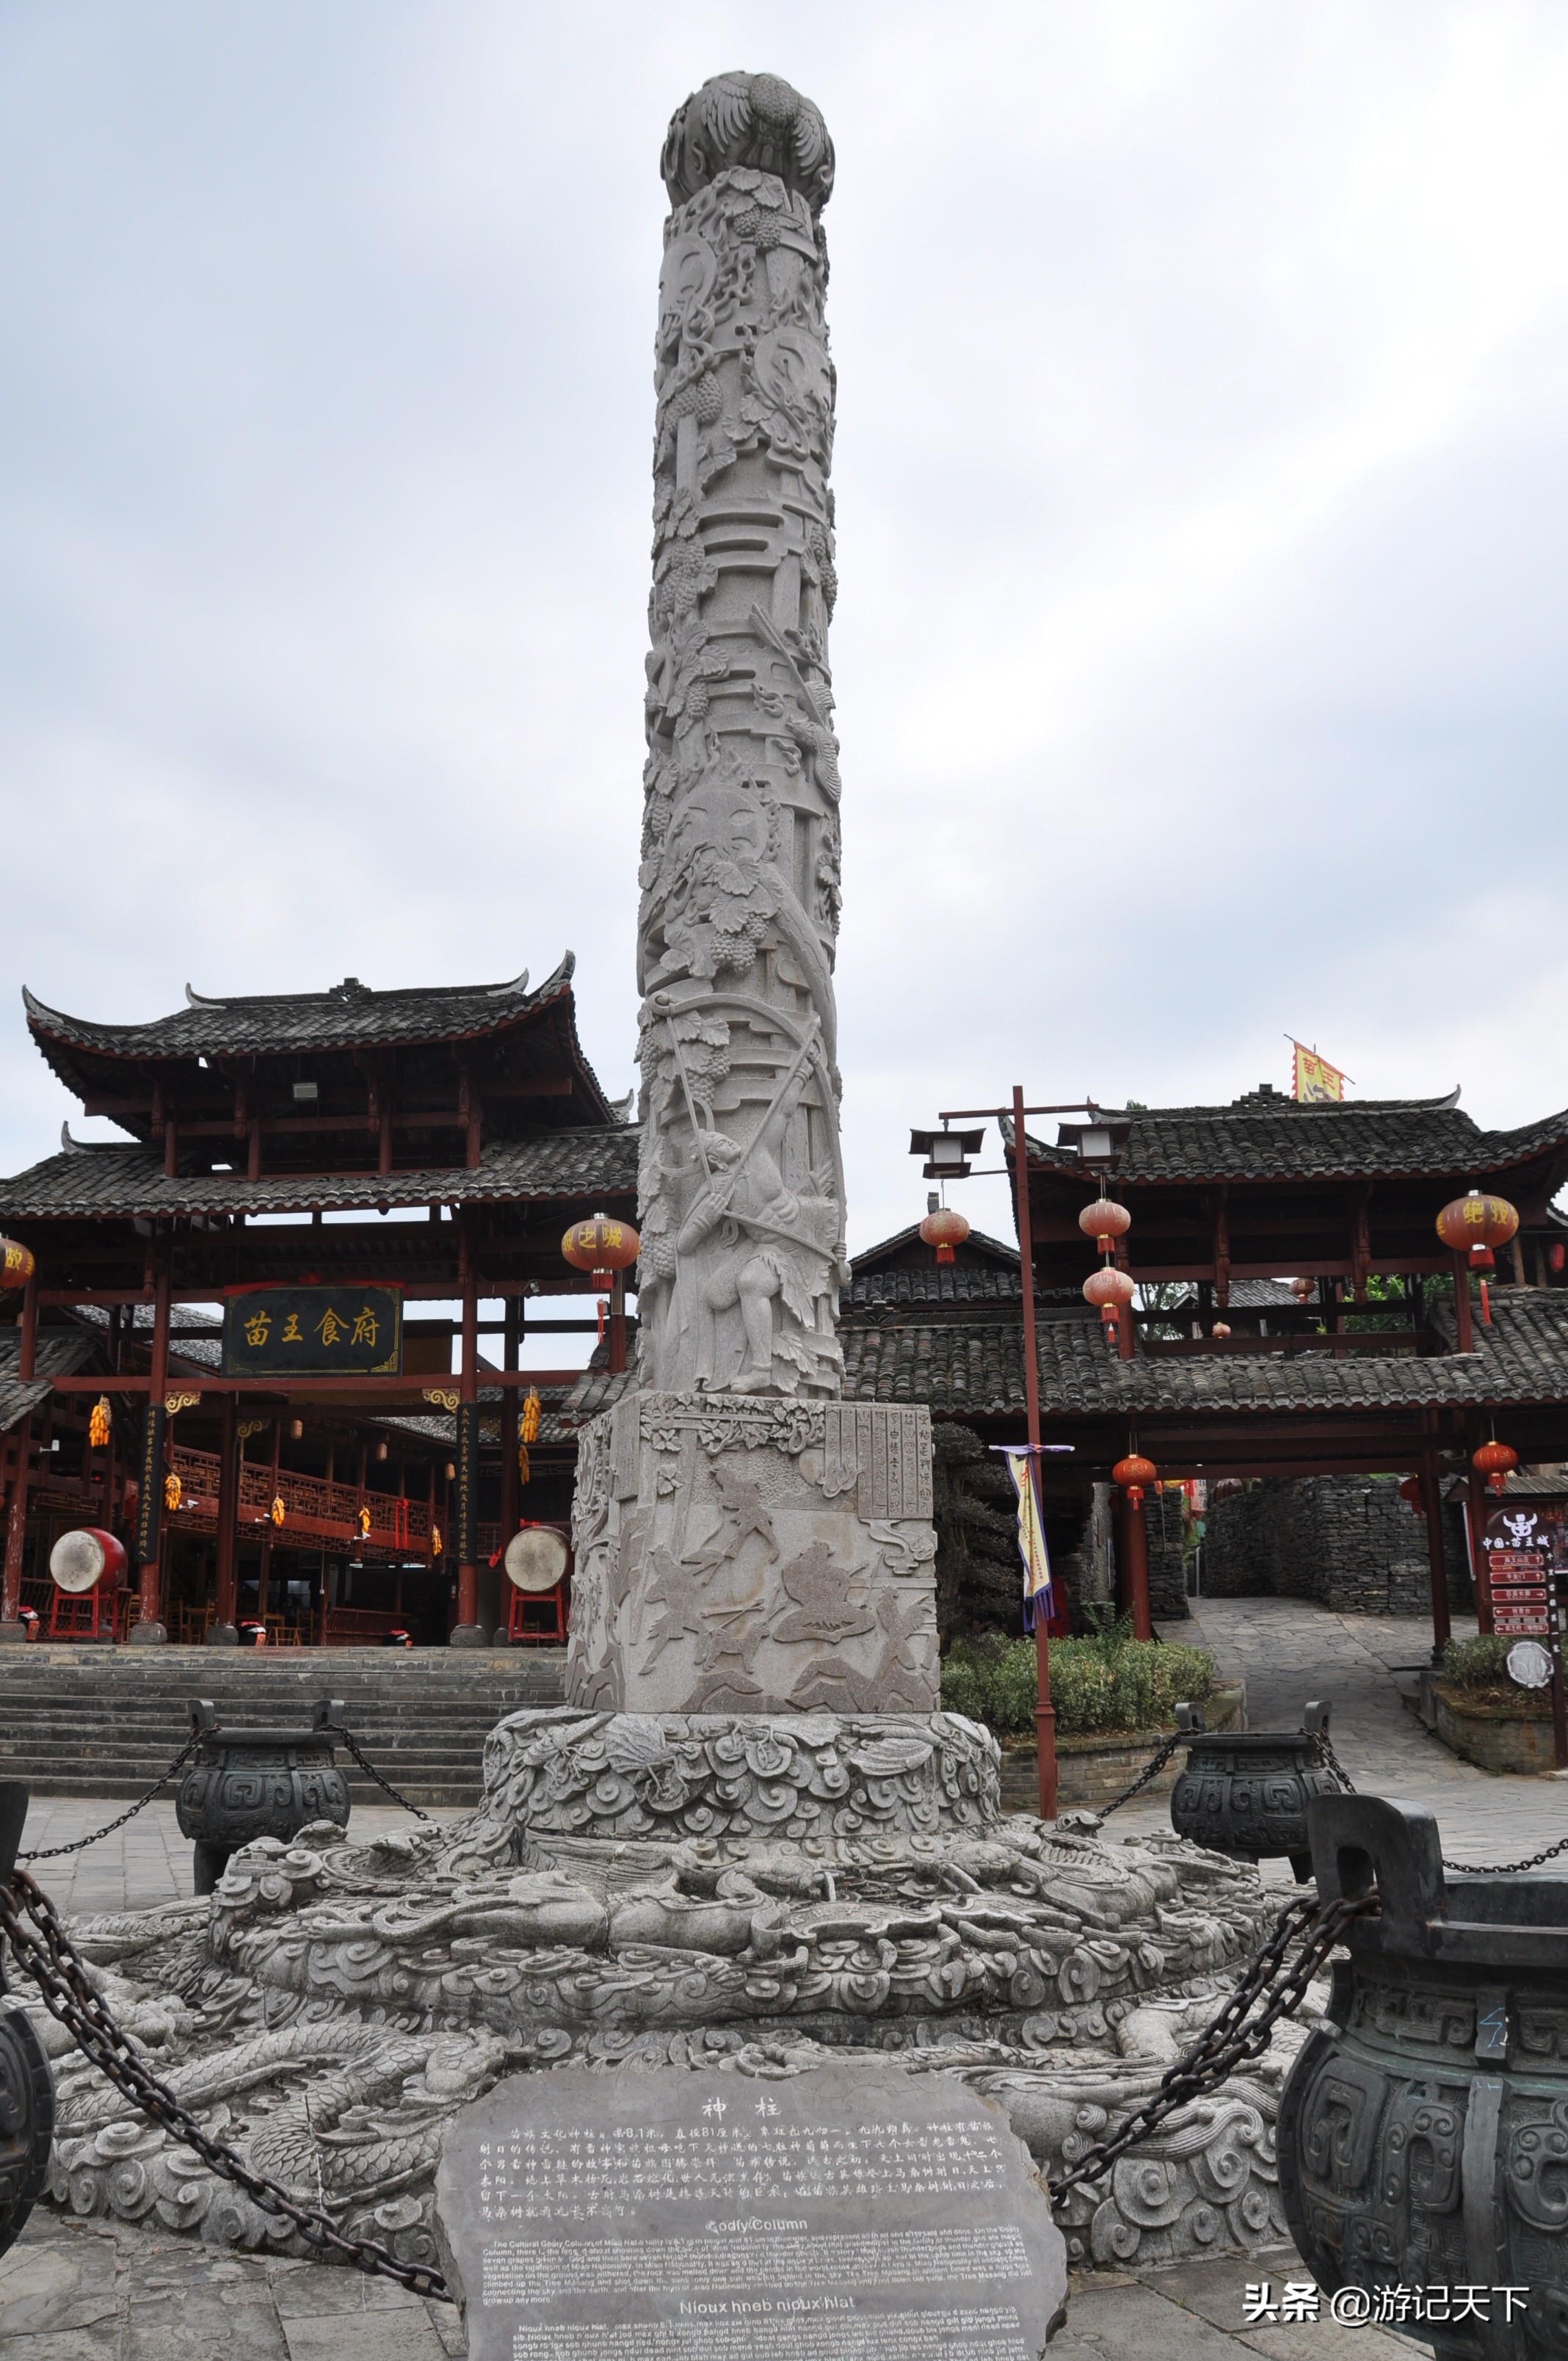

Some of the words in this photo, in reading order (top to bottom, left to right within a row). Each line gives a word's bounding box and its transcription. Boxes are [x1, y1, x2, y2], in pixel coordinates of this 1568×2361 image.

[244, 1307, 380, 1348] 苗王食府
[752, 2219, 807, 2230] Column
[680, 2300, 727, 2314] Nioux
[732, 2299, 772, 2313] hneb
